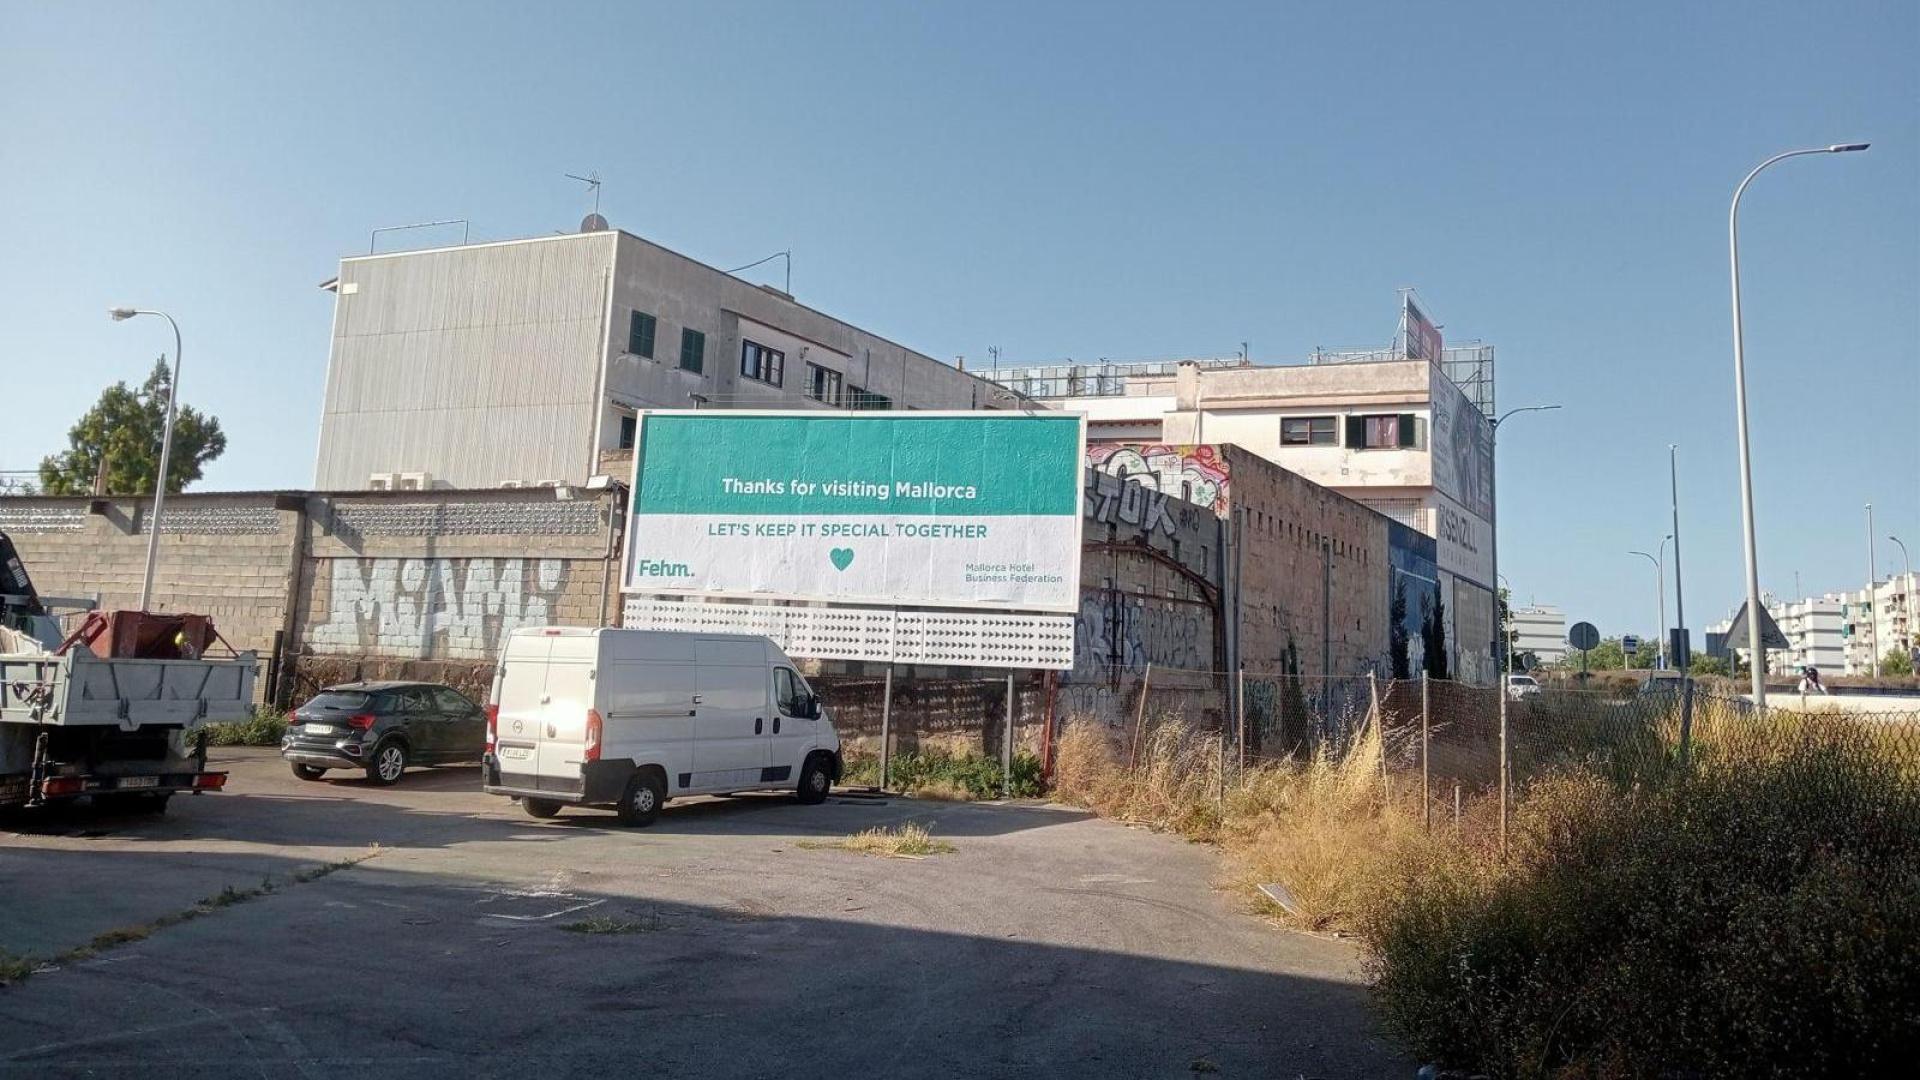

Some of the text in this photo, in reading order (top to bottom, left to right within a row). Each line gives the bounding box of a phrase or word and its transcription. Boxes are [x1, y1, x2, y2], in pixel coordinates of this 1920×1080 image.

[722, 478, 977, 500] Thanks for visiting Mallorca
[708, 522, 988, 539] LET'S KEEP IT SPECIAL TOGETHER
[965, 562, 1035, 573] Mallorca Hotel
[965, 573, 1063, 584] Business Federation
